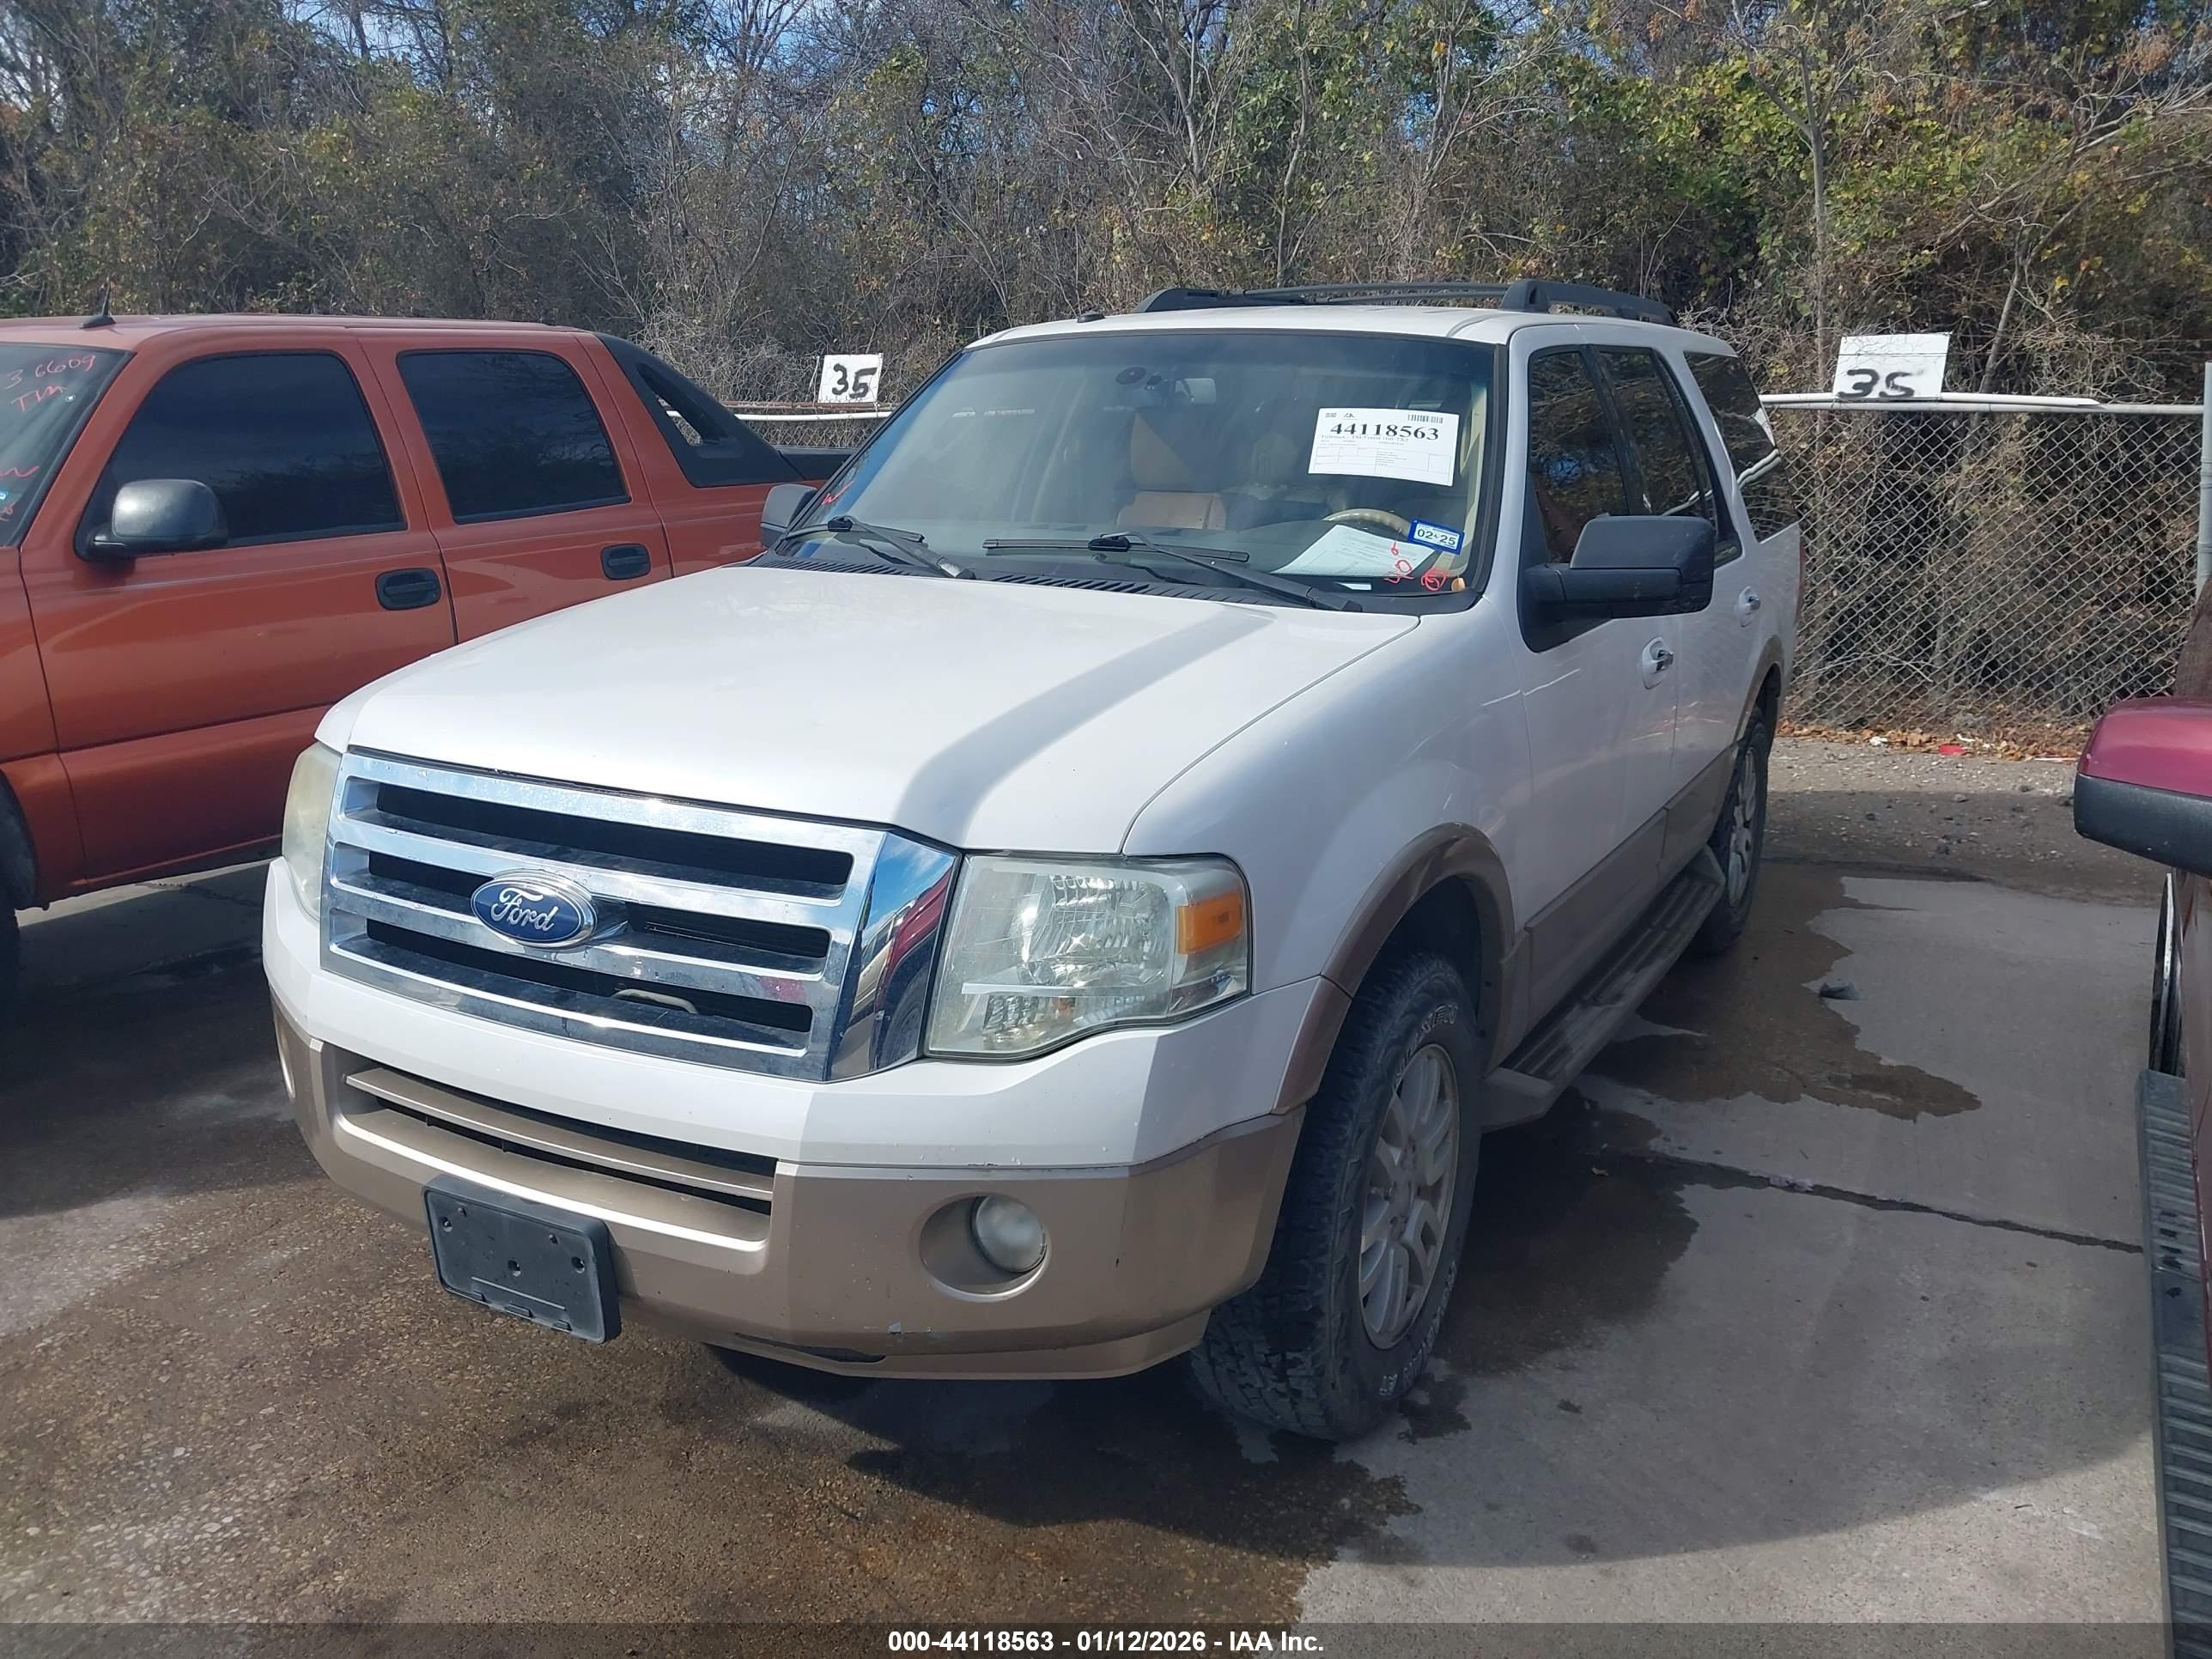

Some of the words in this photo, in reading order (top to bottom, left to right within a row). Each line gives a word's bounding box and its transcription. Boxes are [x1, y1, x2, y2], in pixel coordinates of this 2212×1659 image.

[831, 362, 878, 399] 35
[1837, 368, 1916, 398] 35
[1329, 422, 1439, 441] 44118563
[490, 887, 559, 932] Ford
